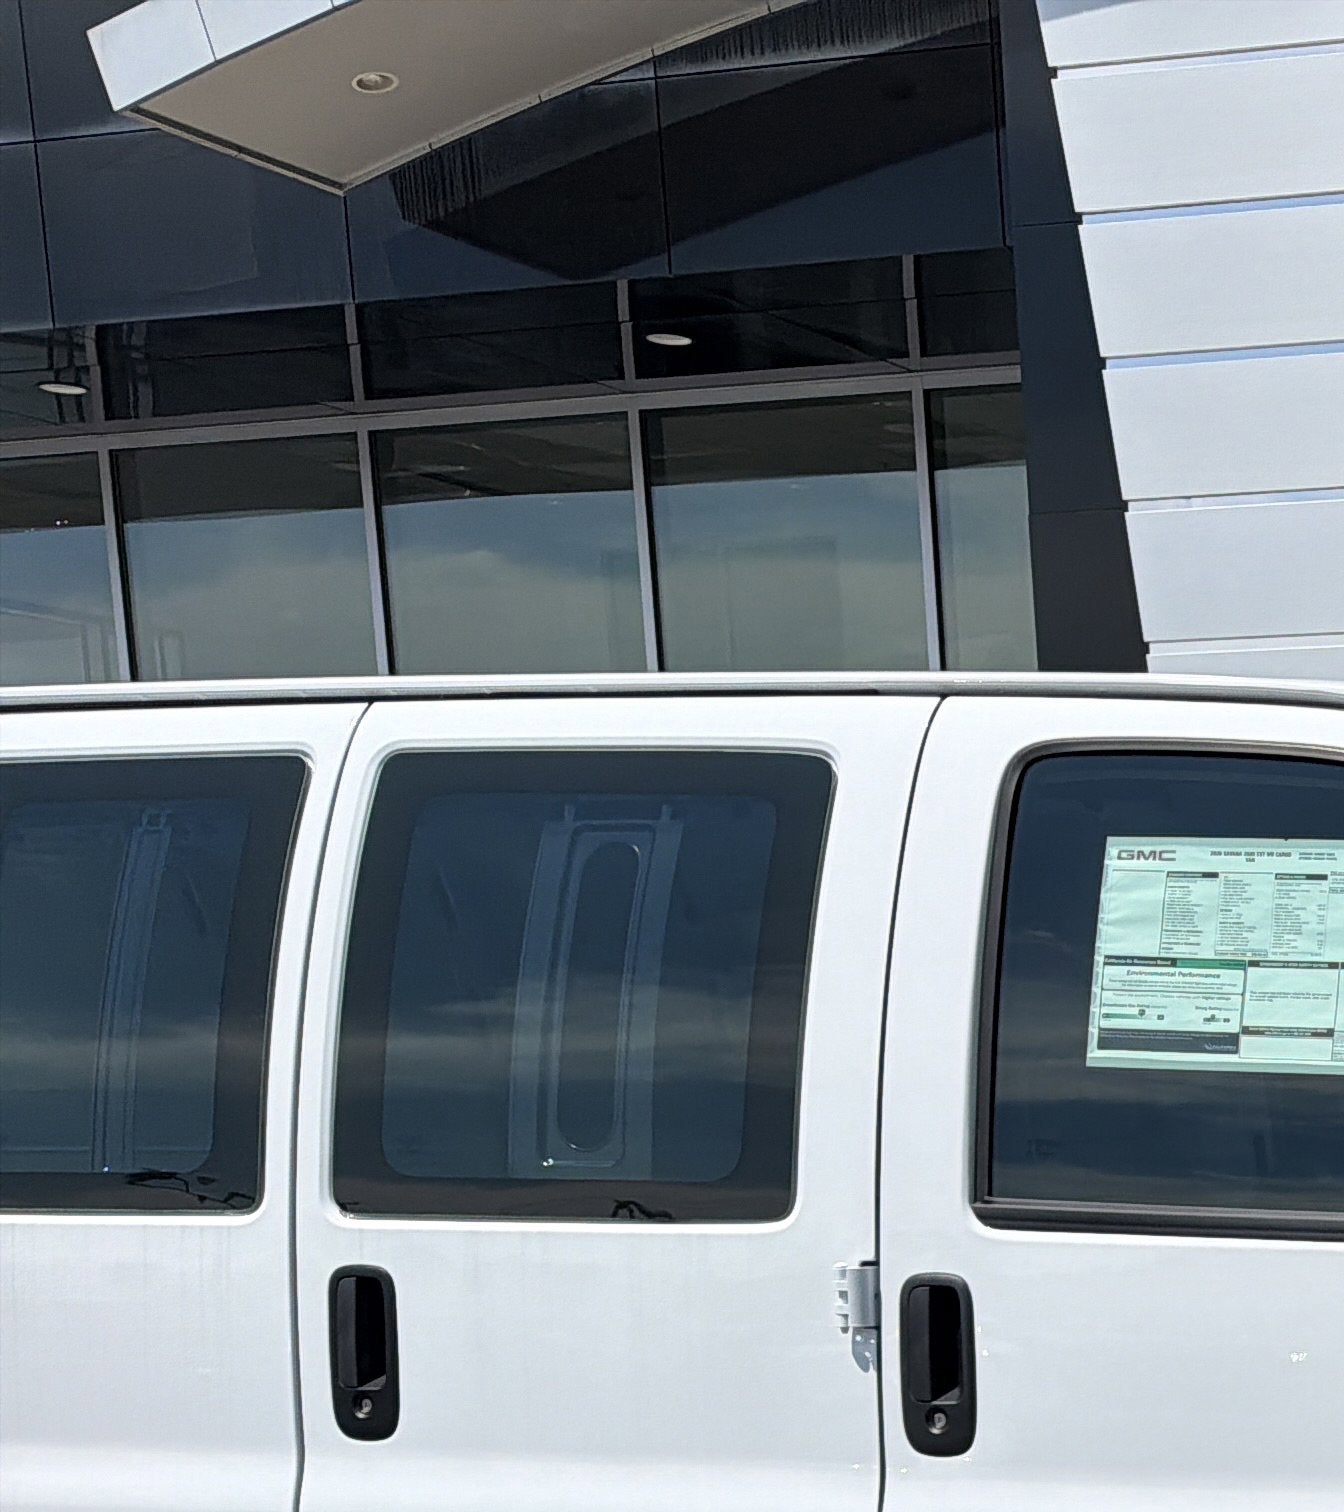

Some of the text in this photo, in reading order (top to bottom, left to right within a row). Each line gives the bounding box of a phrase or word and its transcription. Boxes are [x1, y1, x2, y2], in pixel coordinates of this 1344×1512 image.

[1117, 849, 1177, 862] GMC
[1126, 969, 1221, 979] Environmental Performance
